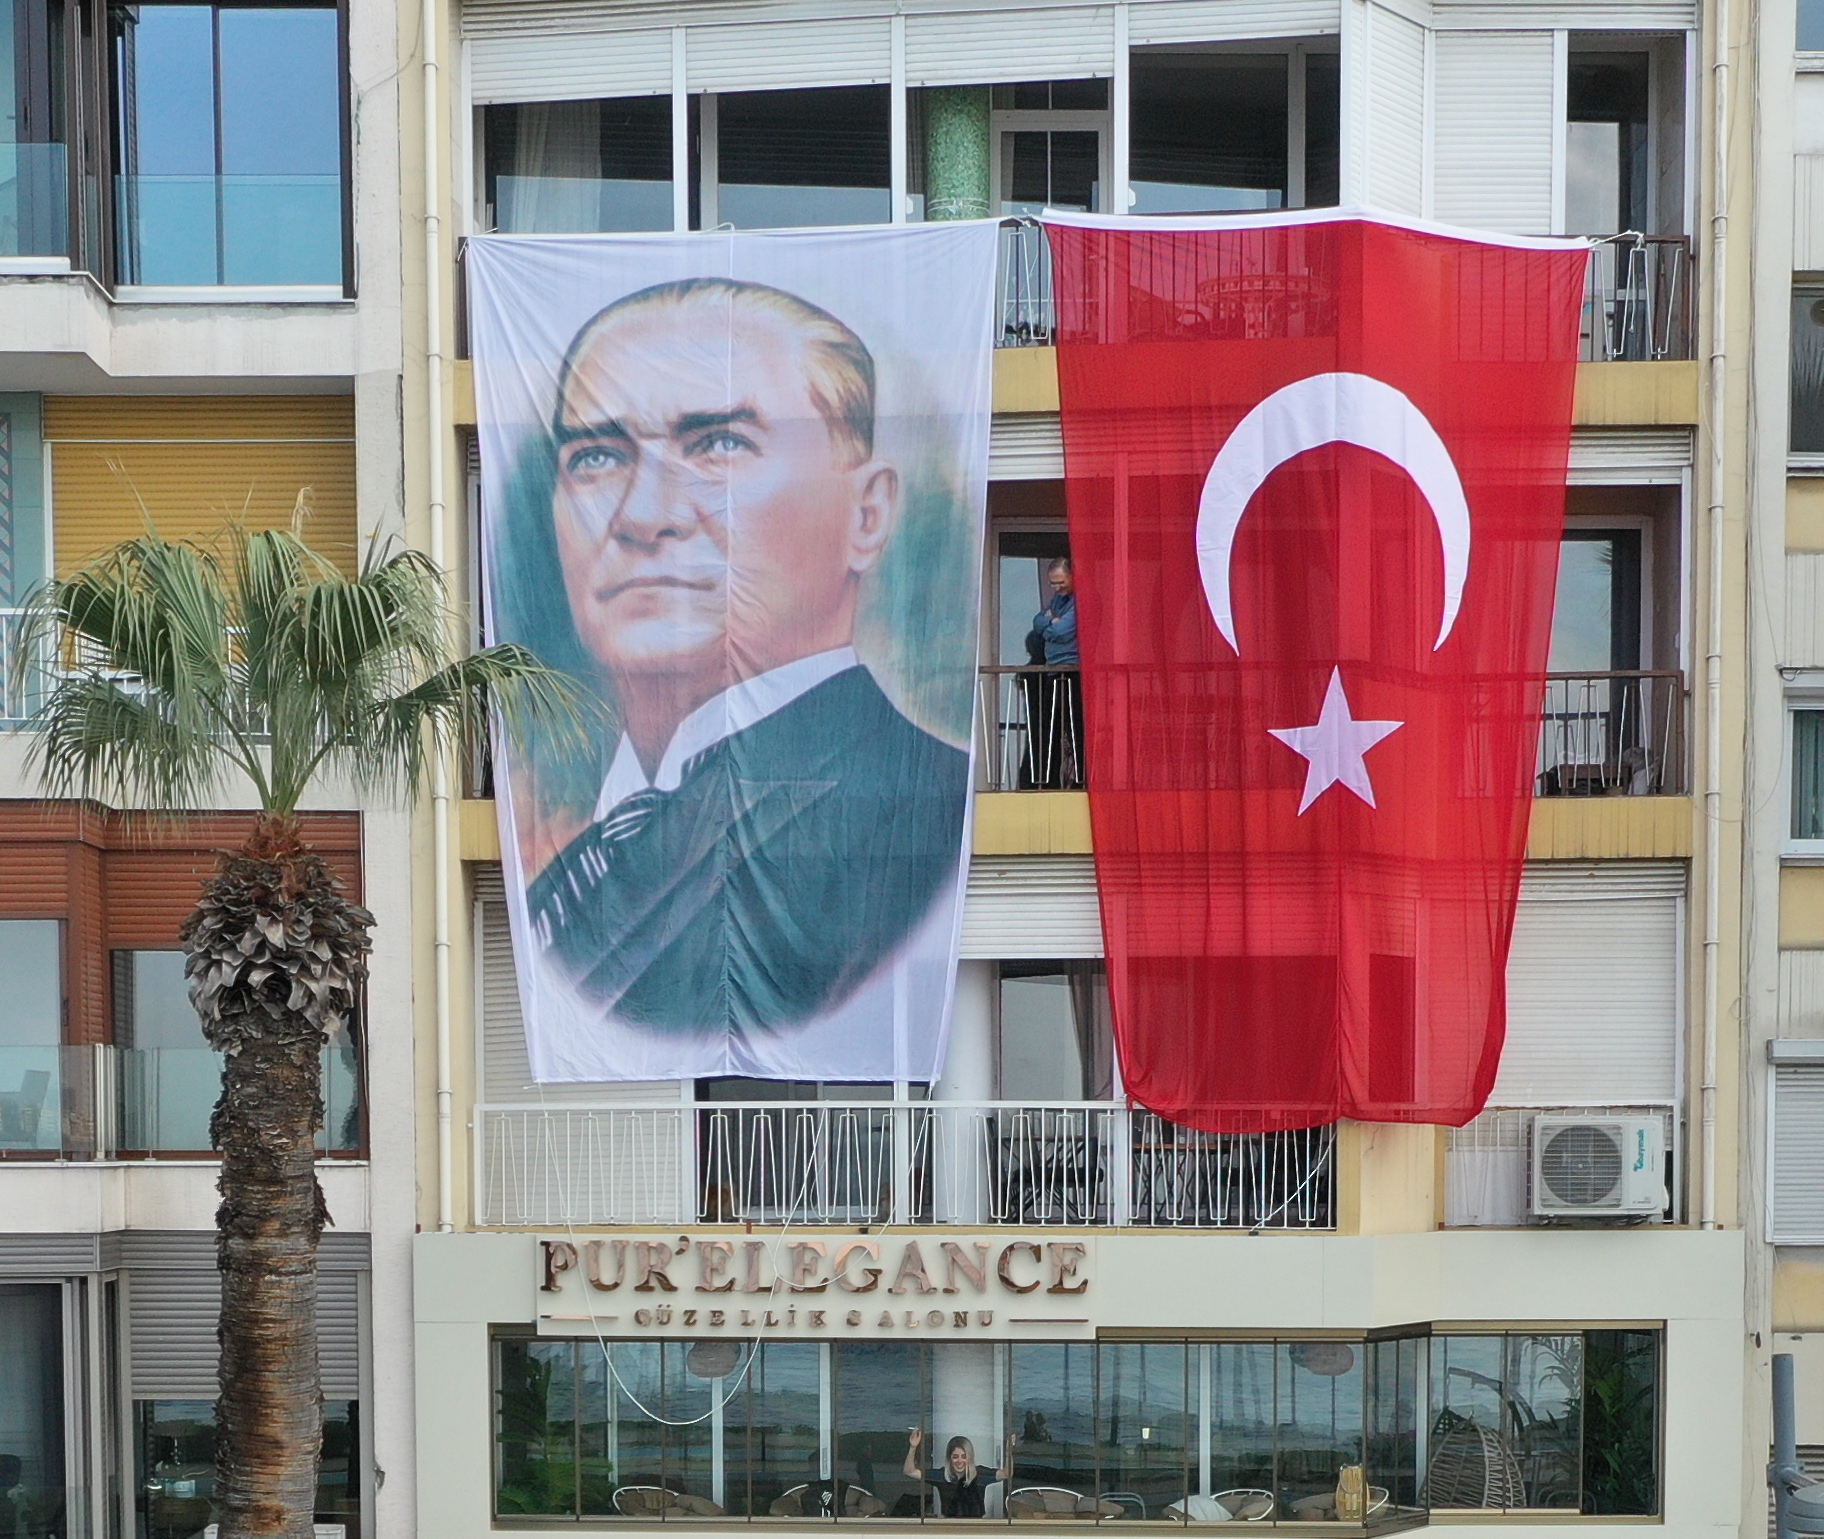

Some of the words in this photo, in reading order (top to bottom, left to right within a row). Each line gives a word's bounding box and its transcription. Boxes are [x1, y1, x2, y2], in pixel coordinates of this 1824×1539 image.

[538, 1234, 1089, 1295] PUR'ELEGANCE
[632, 1303, 826, 1328] GÜZELLİK
[845, 1308, 995, 1329] SALONU
